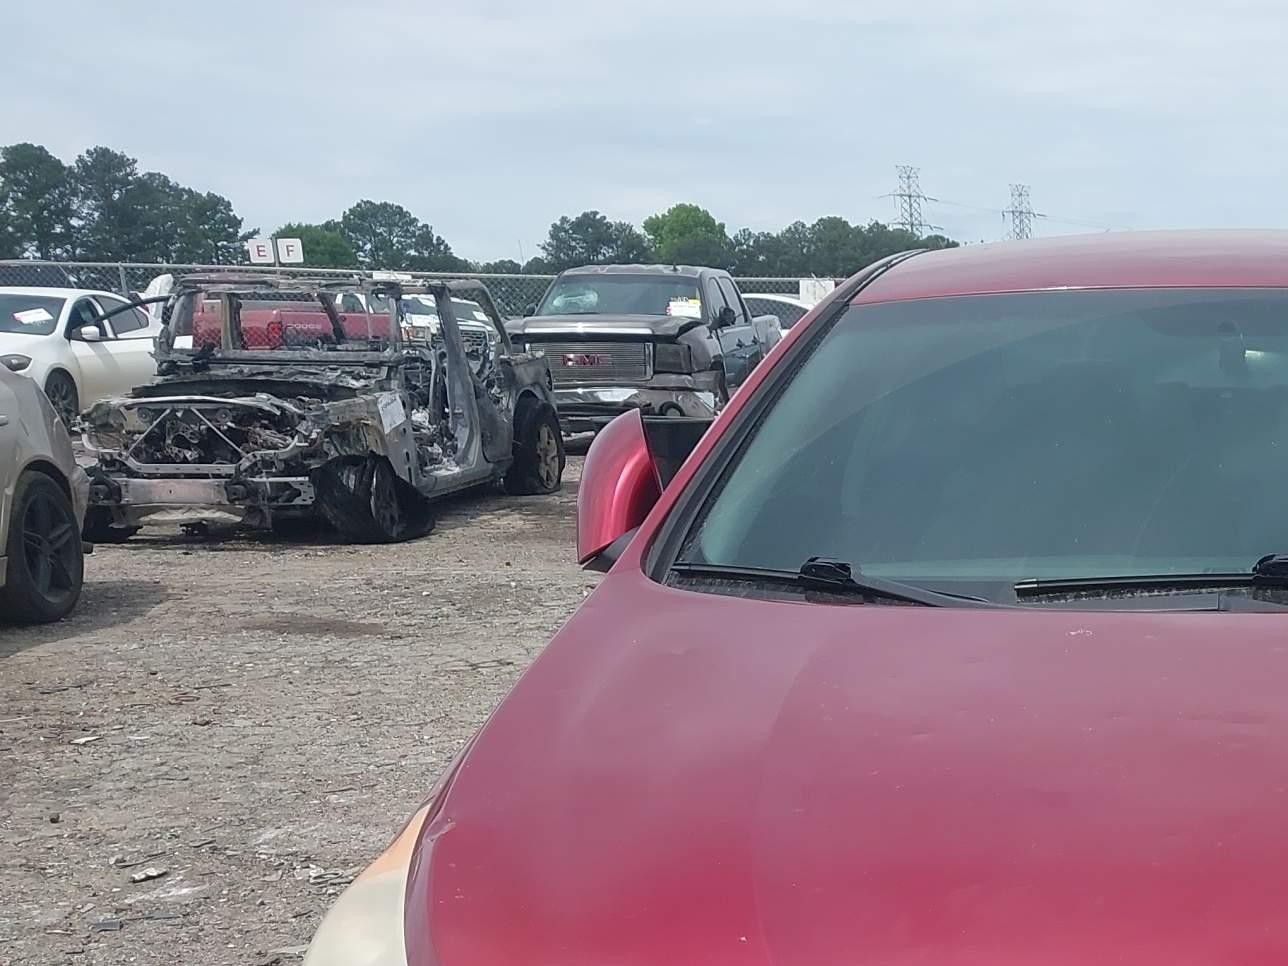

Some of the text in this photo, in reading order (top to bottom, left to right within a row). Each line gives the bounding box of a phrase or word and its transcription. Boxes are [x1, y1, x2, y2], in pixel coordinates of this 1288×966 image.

[256, 244, 267, 257] E
[286, 244, 295, 257] F
[562, 353, 613, 367] GMC
